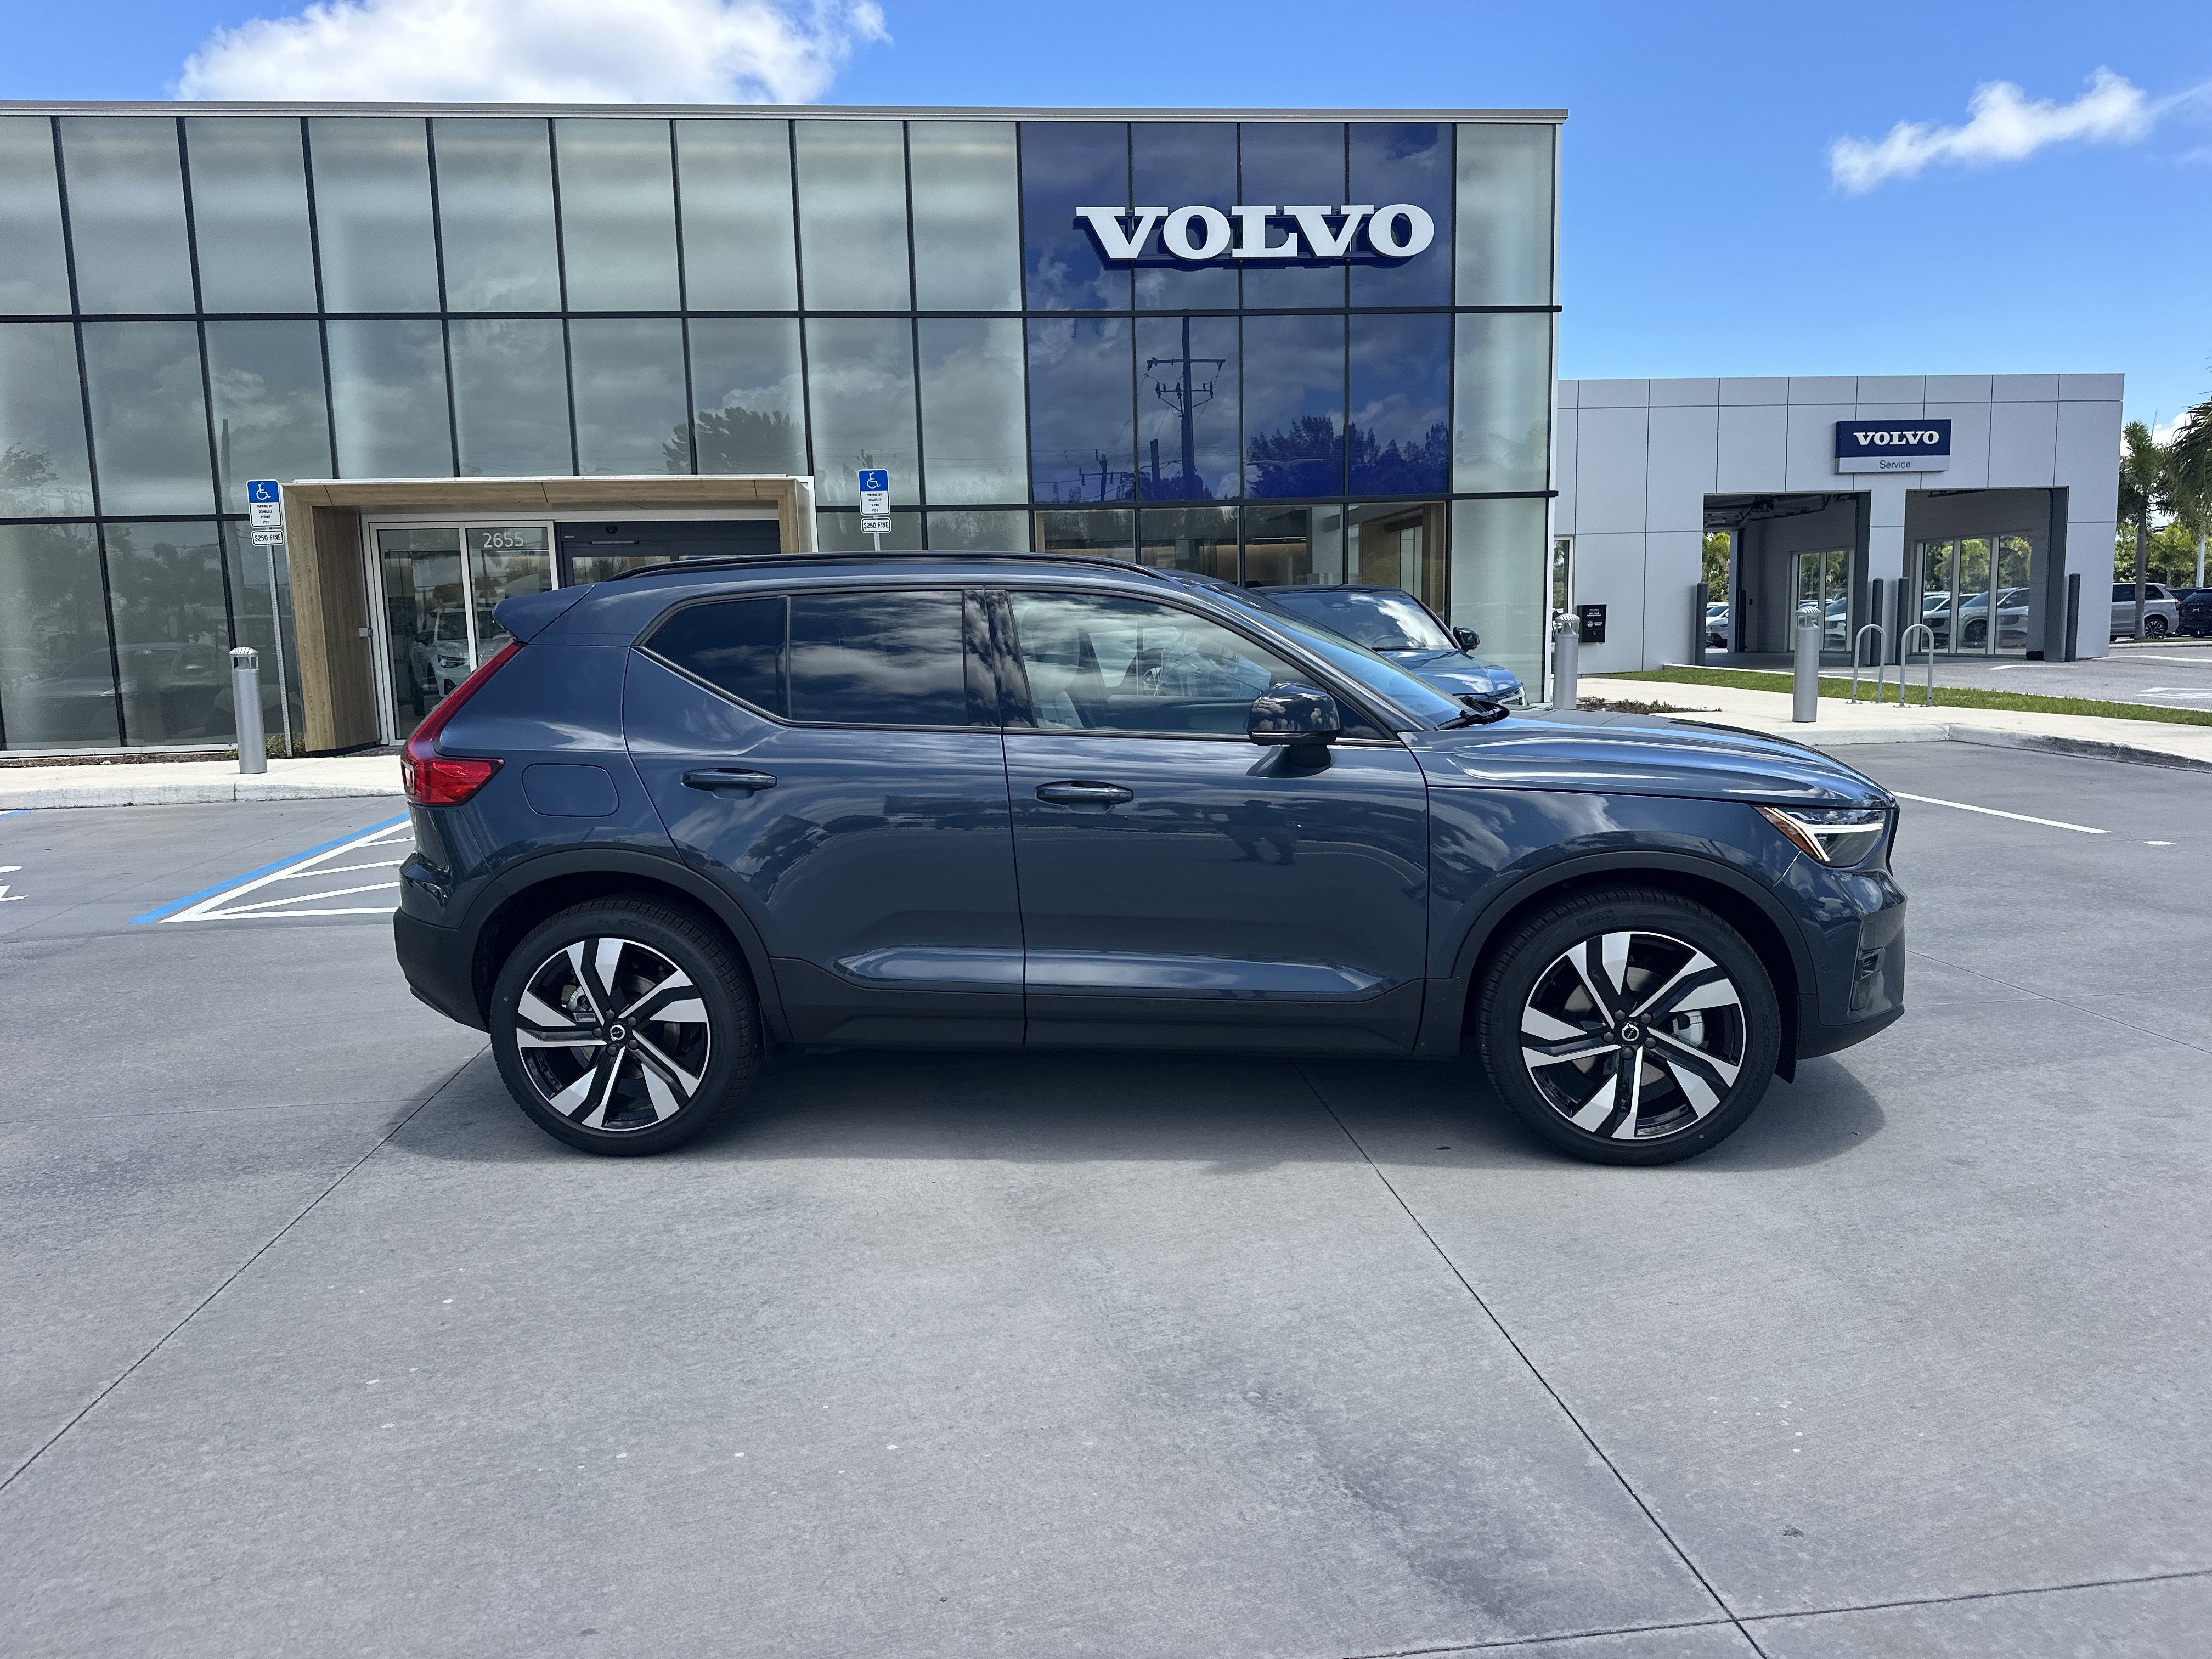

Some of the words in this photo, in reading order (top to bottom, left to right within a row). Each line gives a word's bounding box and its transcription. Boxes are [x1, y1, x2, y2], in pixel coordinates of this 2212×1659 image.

[1076, 204, 1434, 259] VOLVO
[1853, 431, 1939, 445] VOLVO
[1879, 460, 1911, 469] Service
[483, 532, 524, 548] 2655
